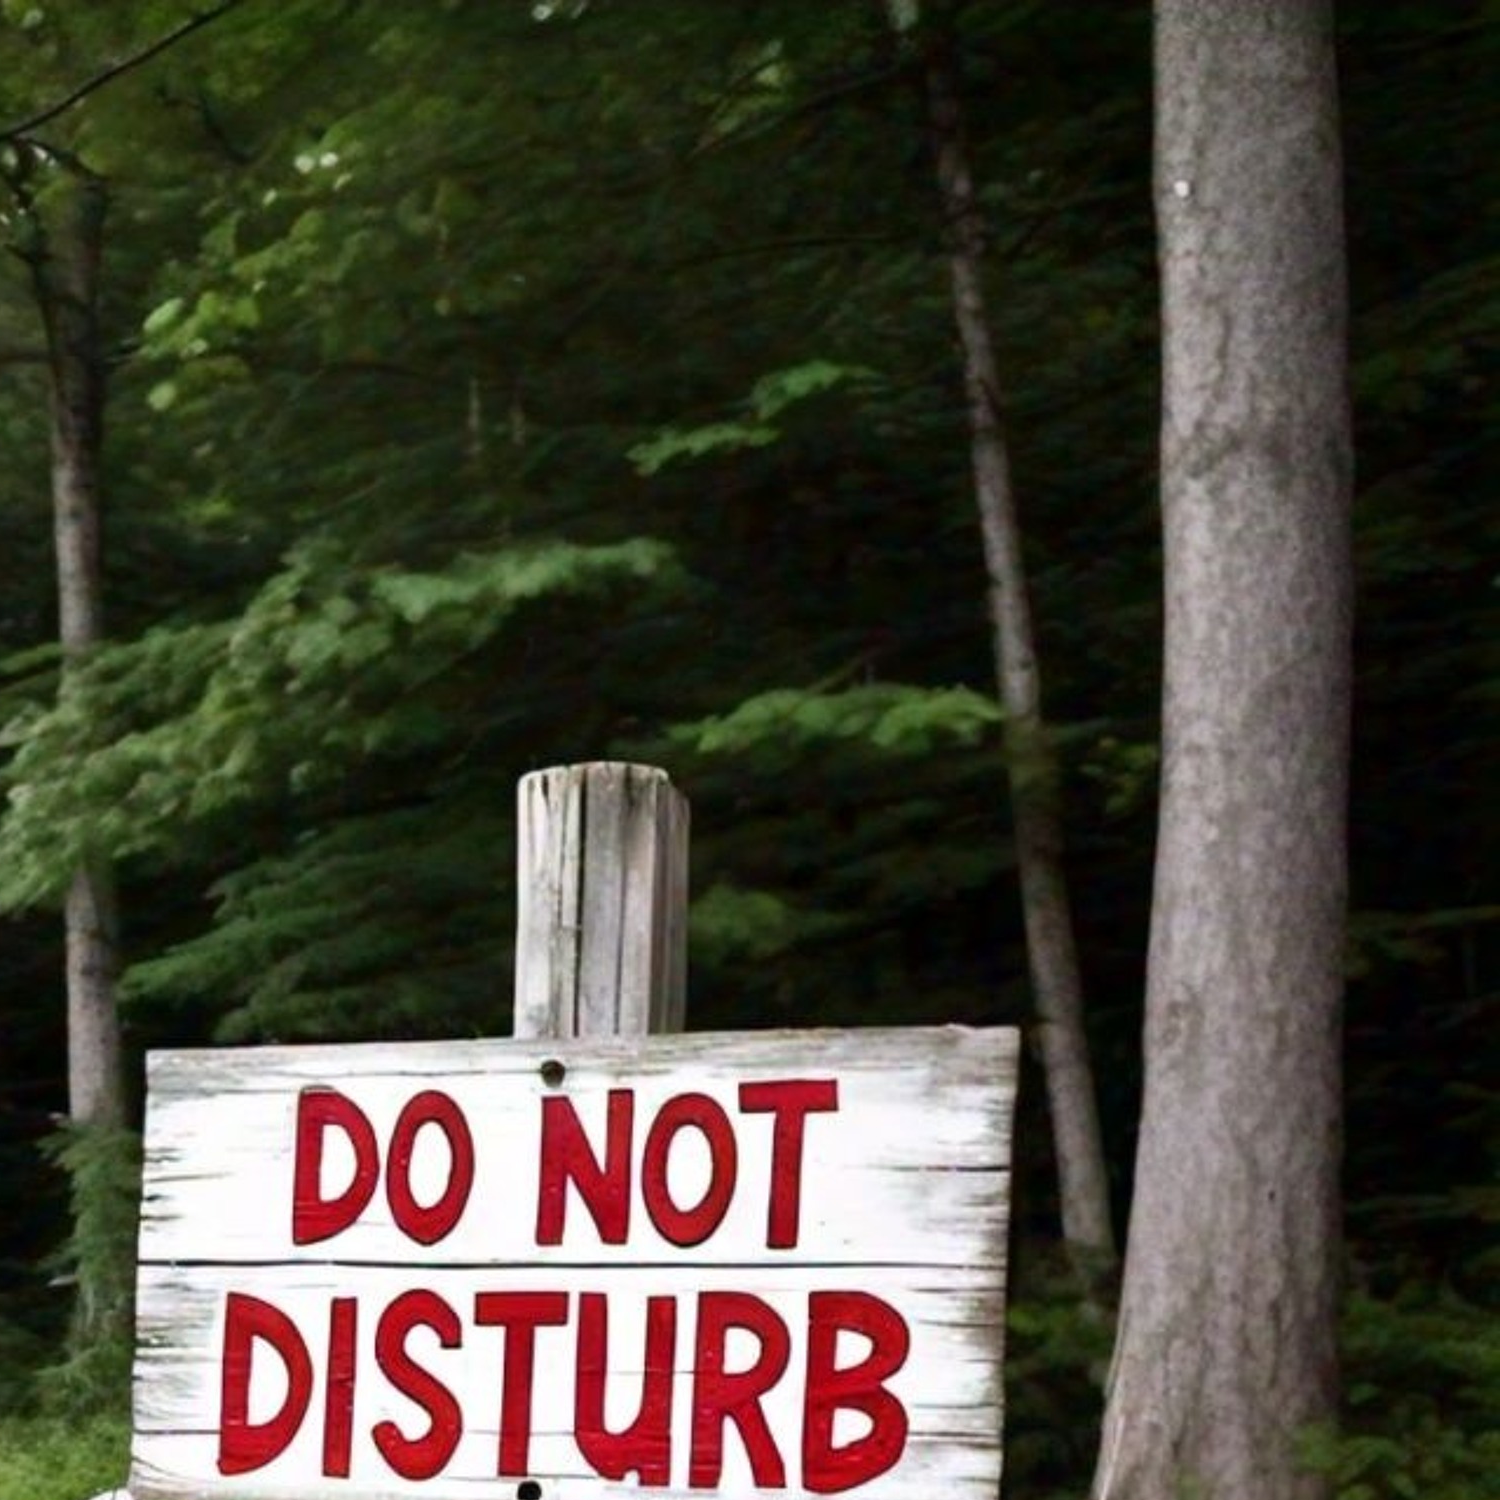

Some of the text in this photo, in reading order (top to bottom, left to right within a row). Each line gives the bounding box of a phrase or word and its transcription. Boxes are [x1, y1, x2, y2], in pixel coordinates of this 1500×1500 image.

[292, 1079, 839, 1249] DO NOT
[217, 1288, 910, 1495] DISTURB
